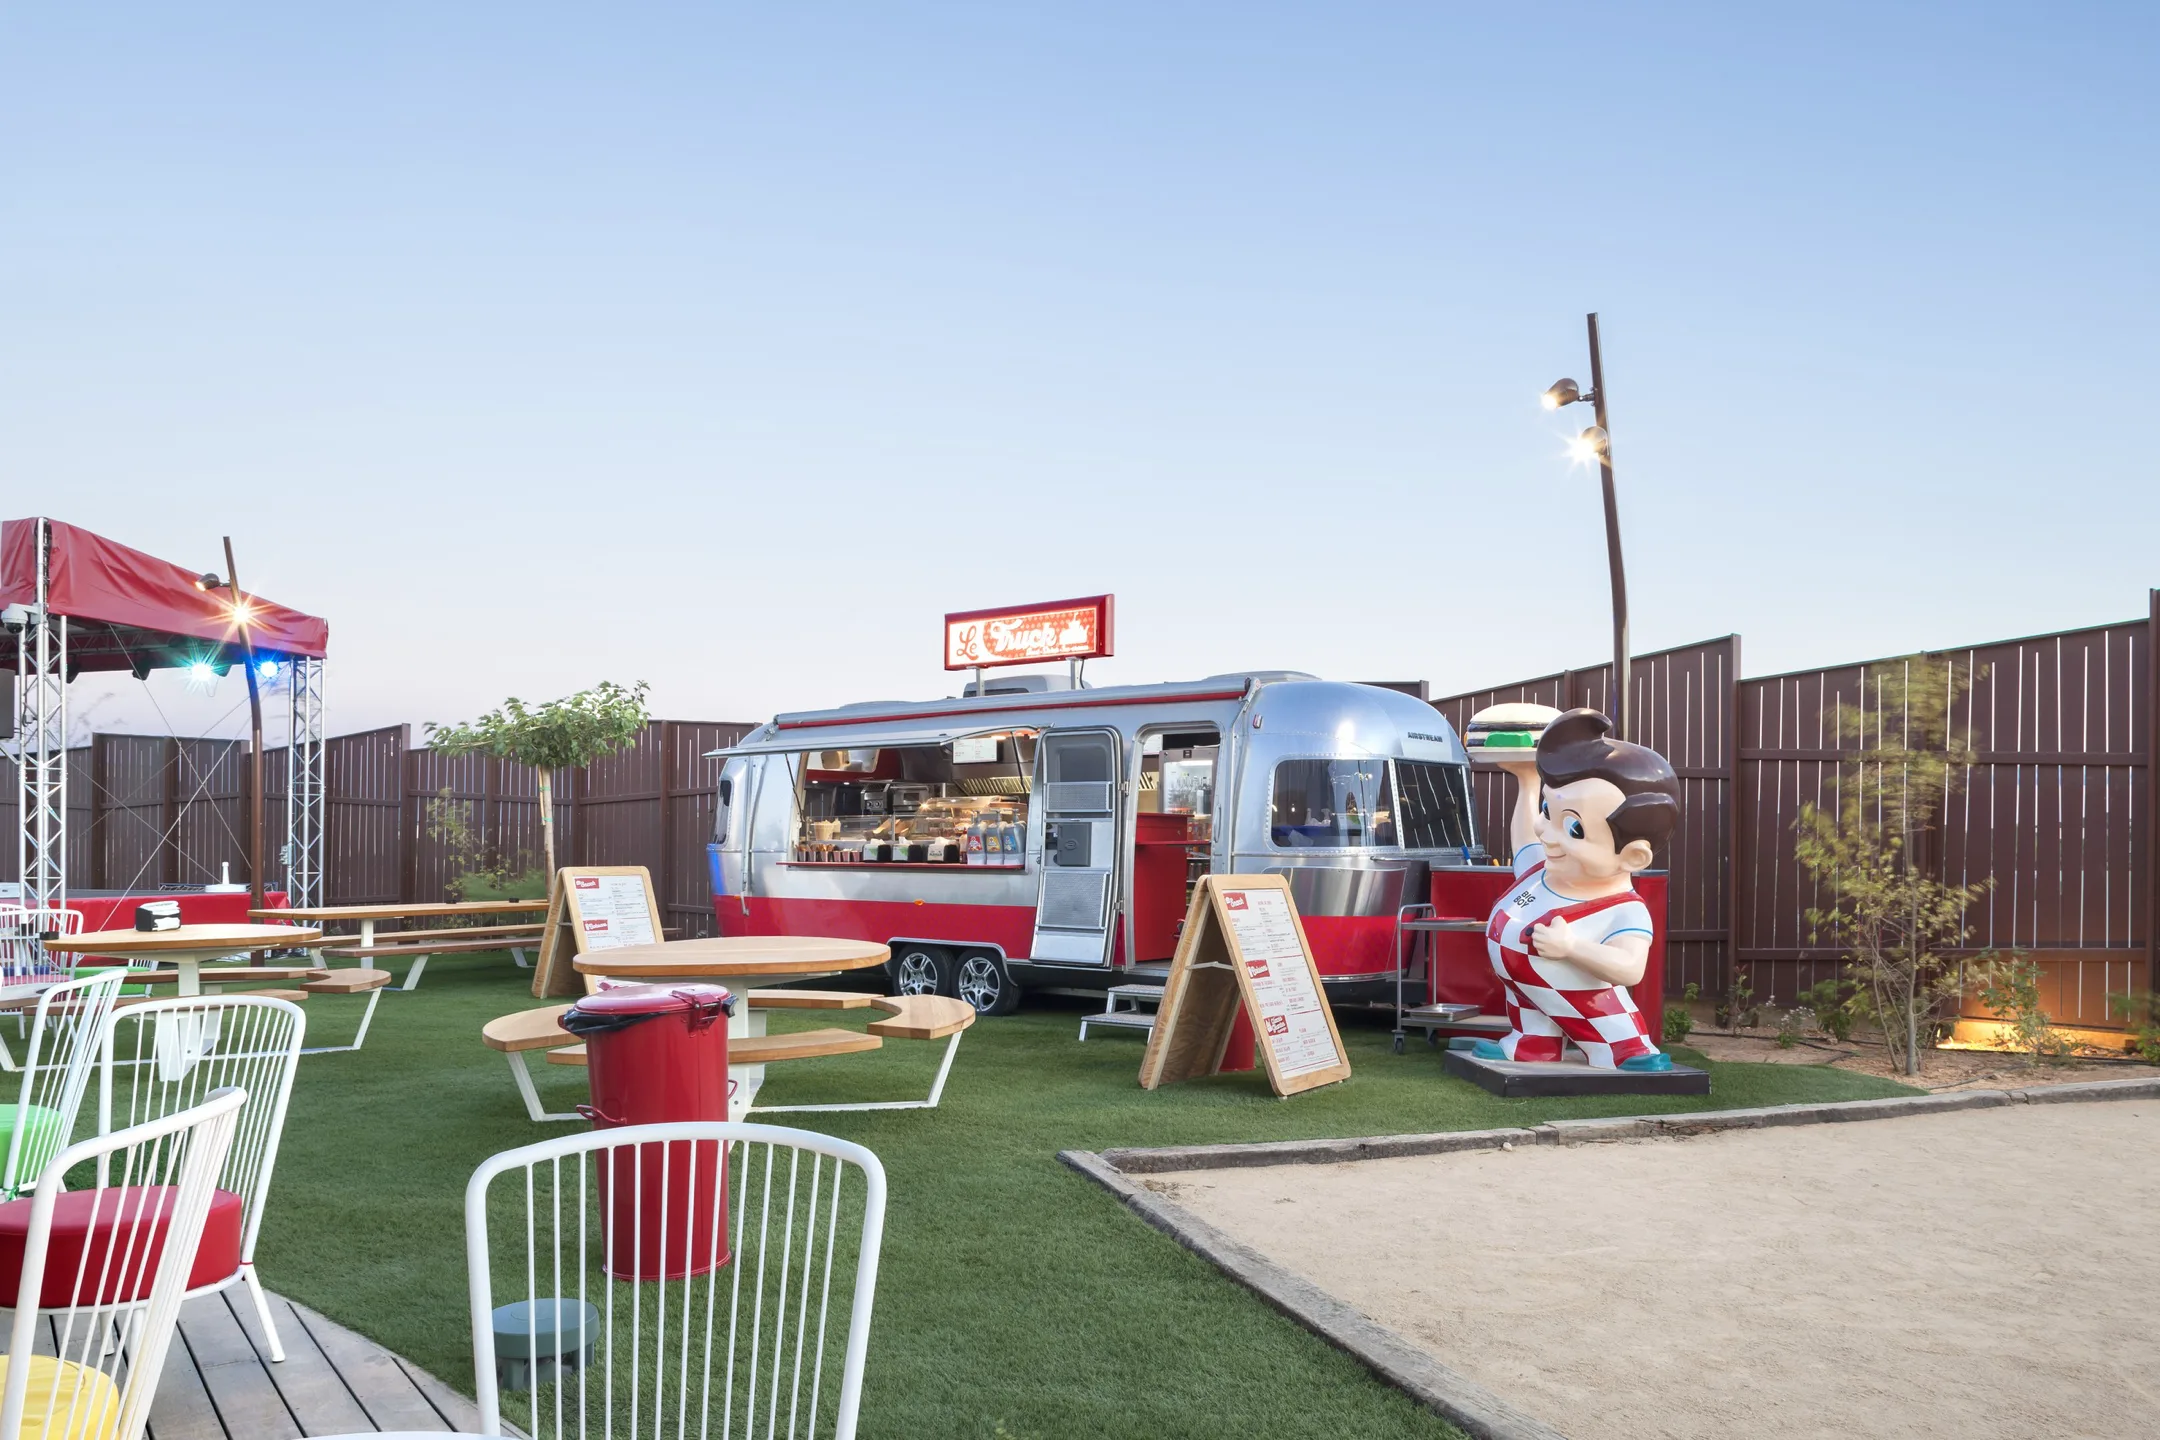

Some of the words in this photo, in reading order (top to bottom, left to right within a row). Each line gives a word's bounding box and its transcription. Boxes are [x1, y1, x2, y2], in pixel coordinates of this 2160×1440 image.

[956, 625, 980, 661] Le
[990, 618, 1057, 652] Truck
[1407, 731, 1443, 743] AIRSTREAM
[1513, 895, 1529, 908] BOY
[1521, 890, 1536, 903] BIG
